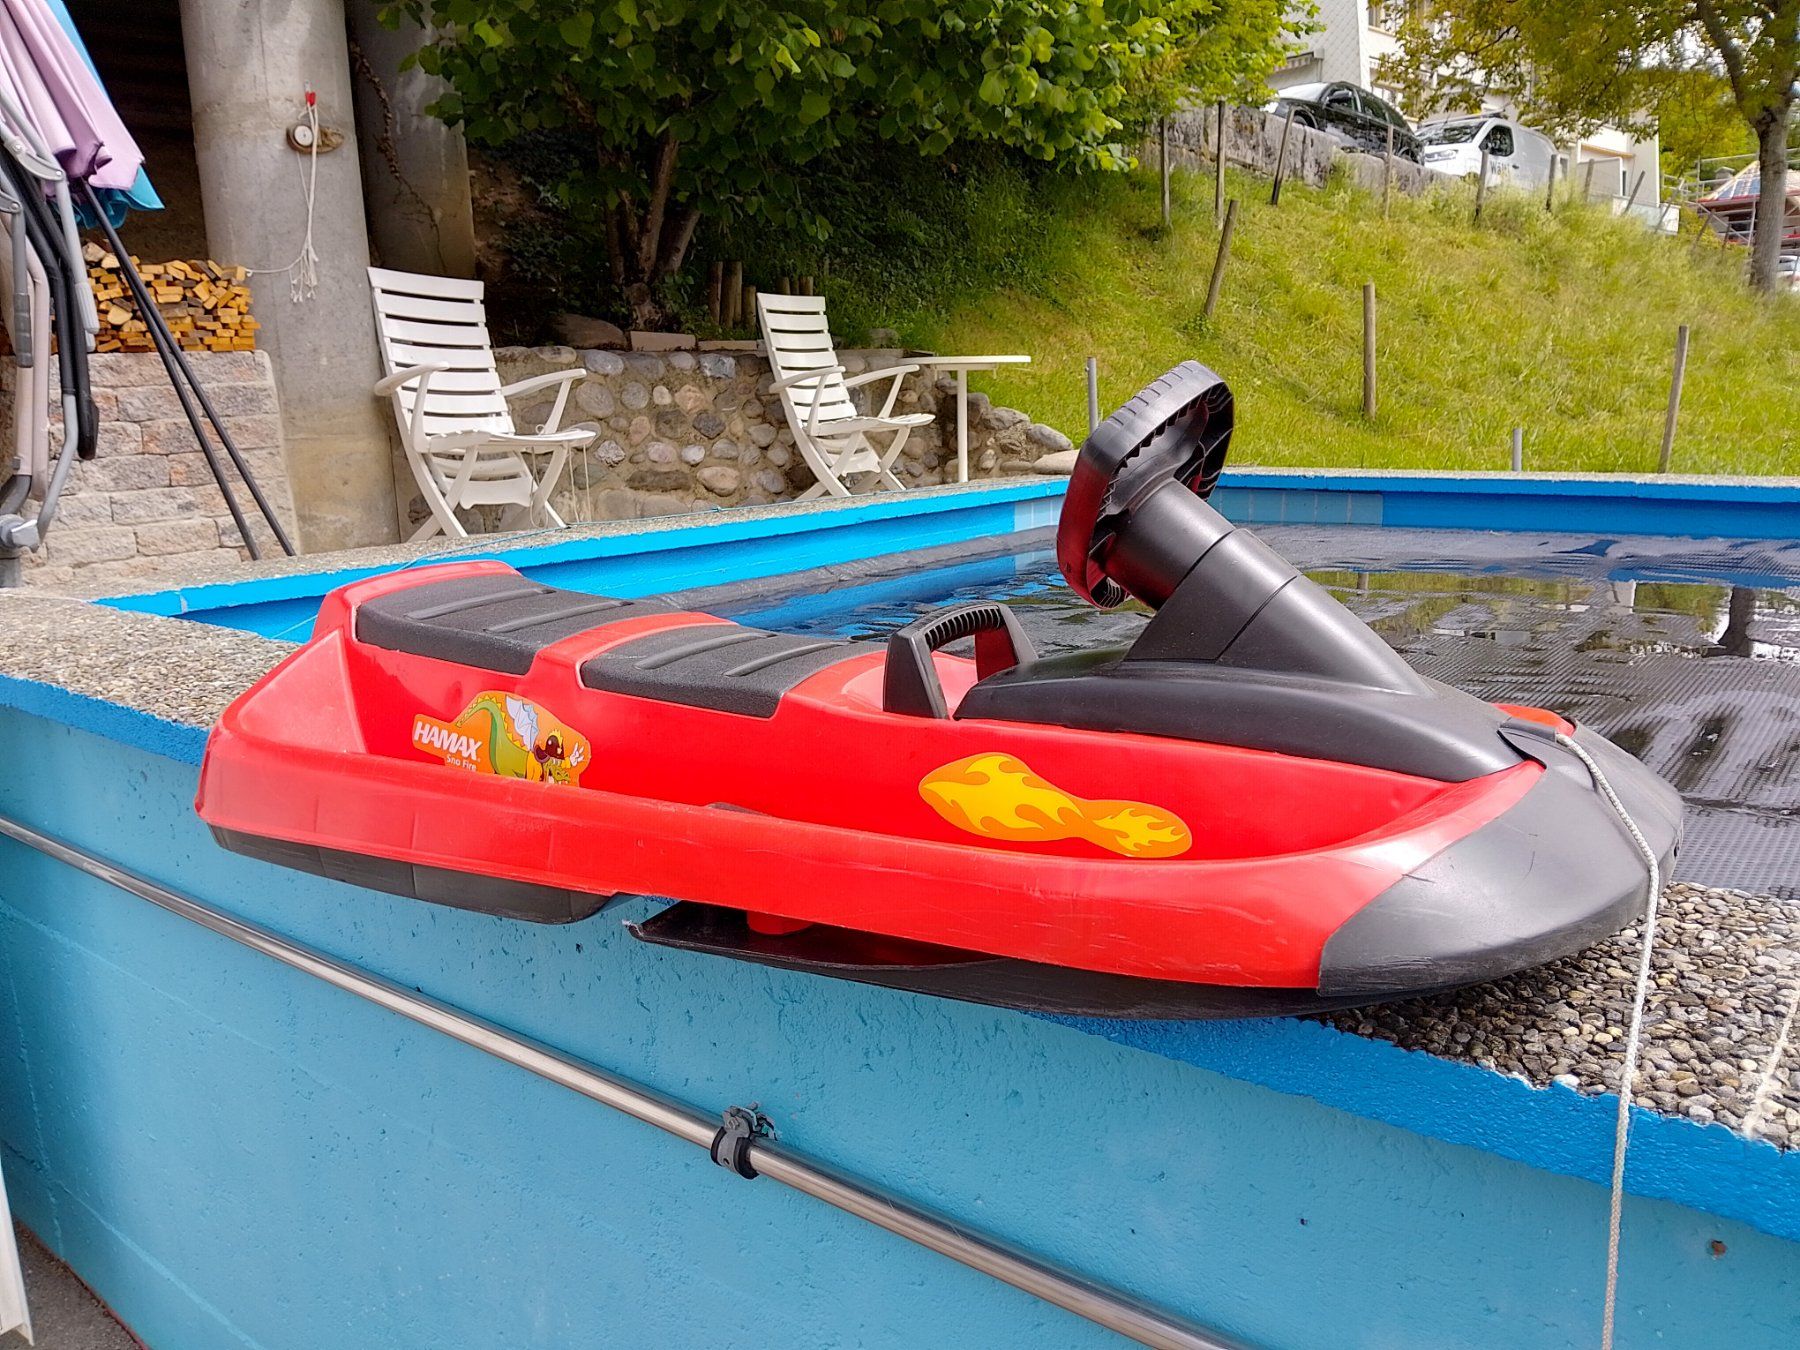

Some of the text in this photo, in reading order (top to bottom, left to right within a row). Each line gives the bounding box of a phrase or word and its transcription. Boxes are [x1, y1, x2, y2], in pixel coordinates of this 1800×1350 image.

[414, 721, 482, 760] HAMAX
[447, 754, 477, 771] Sno Fire
